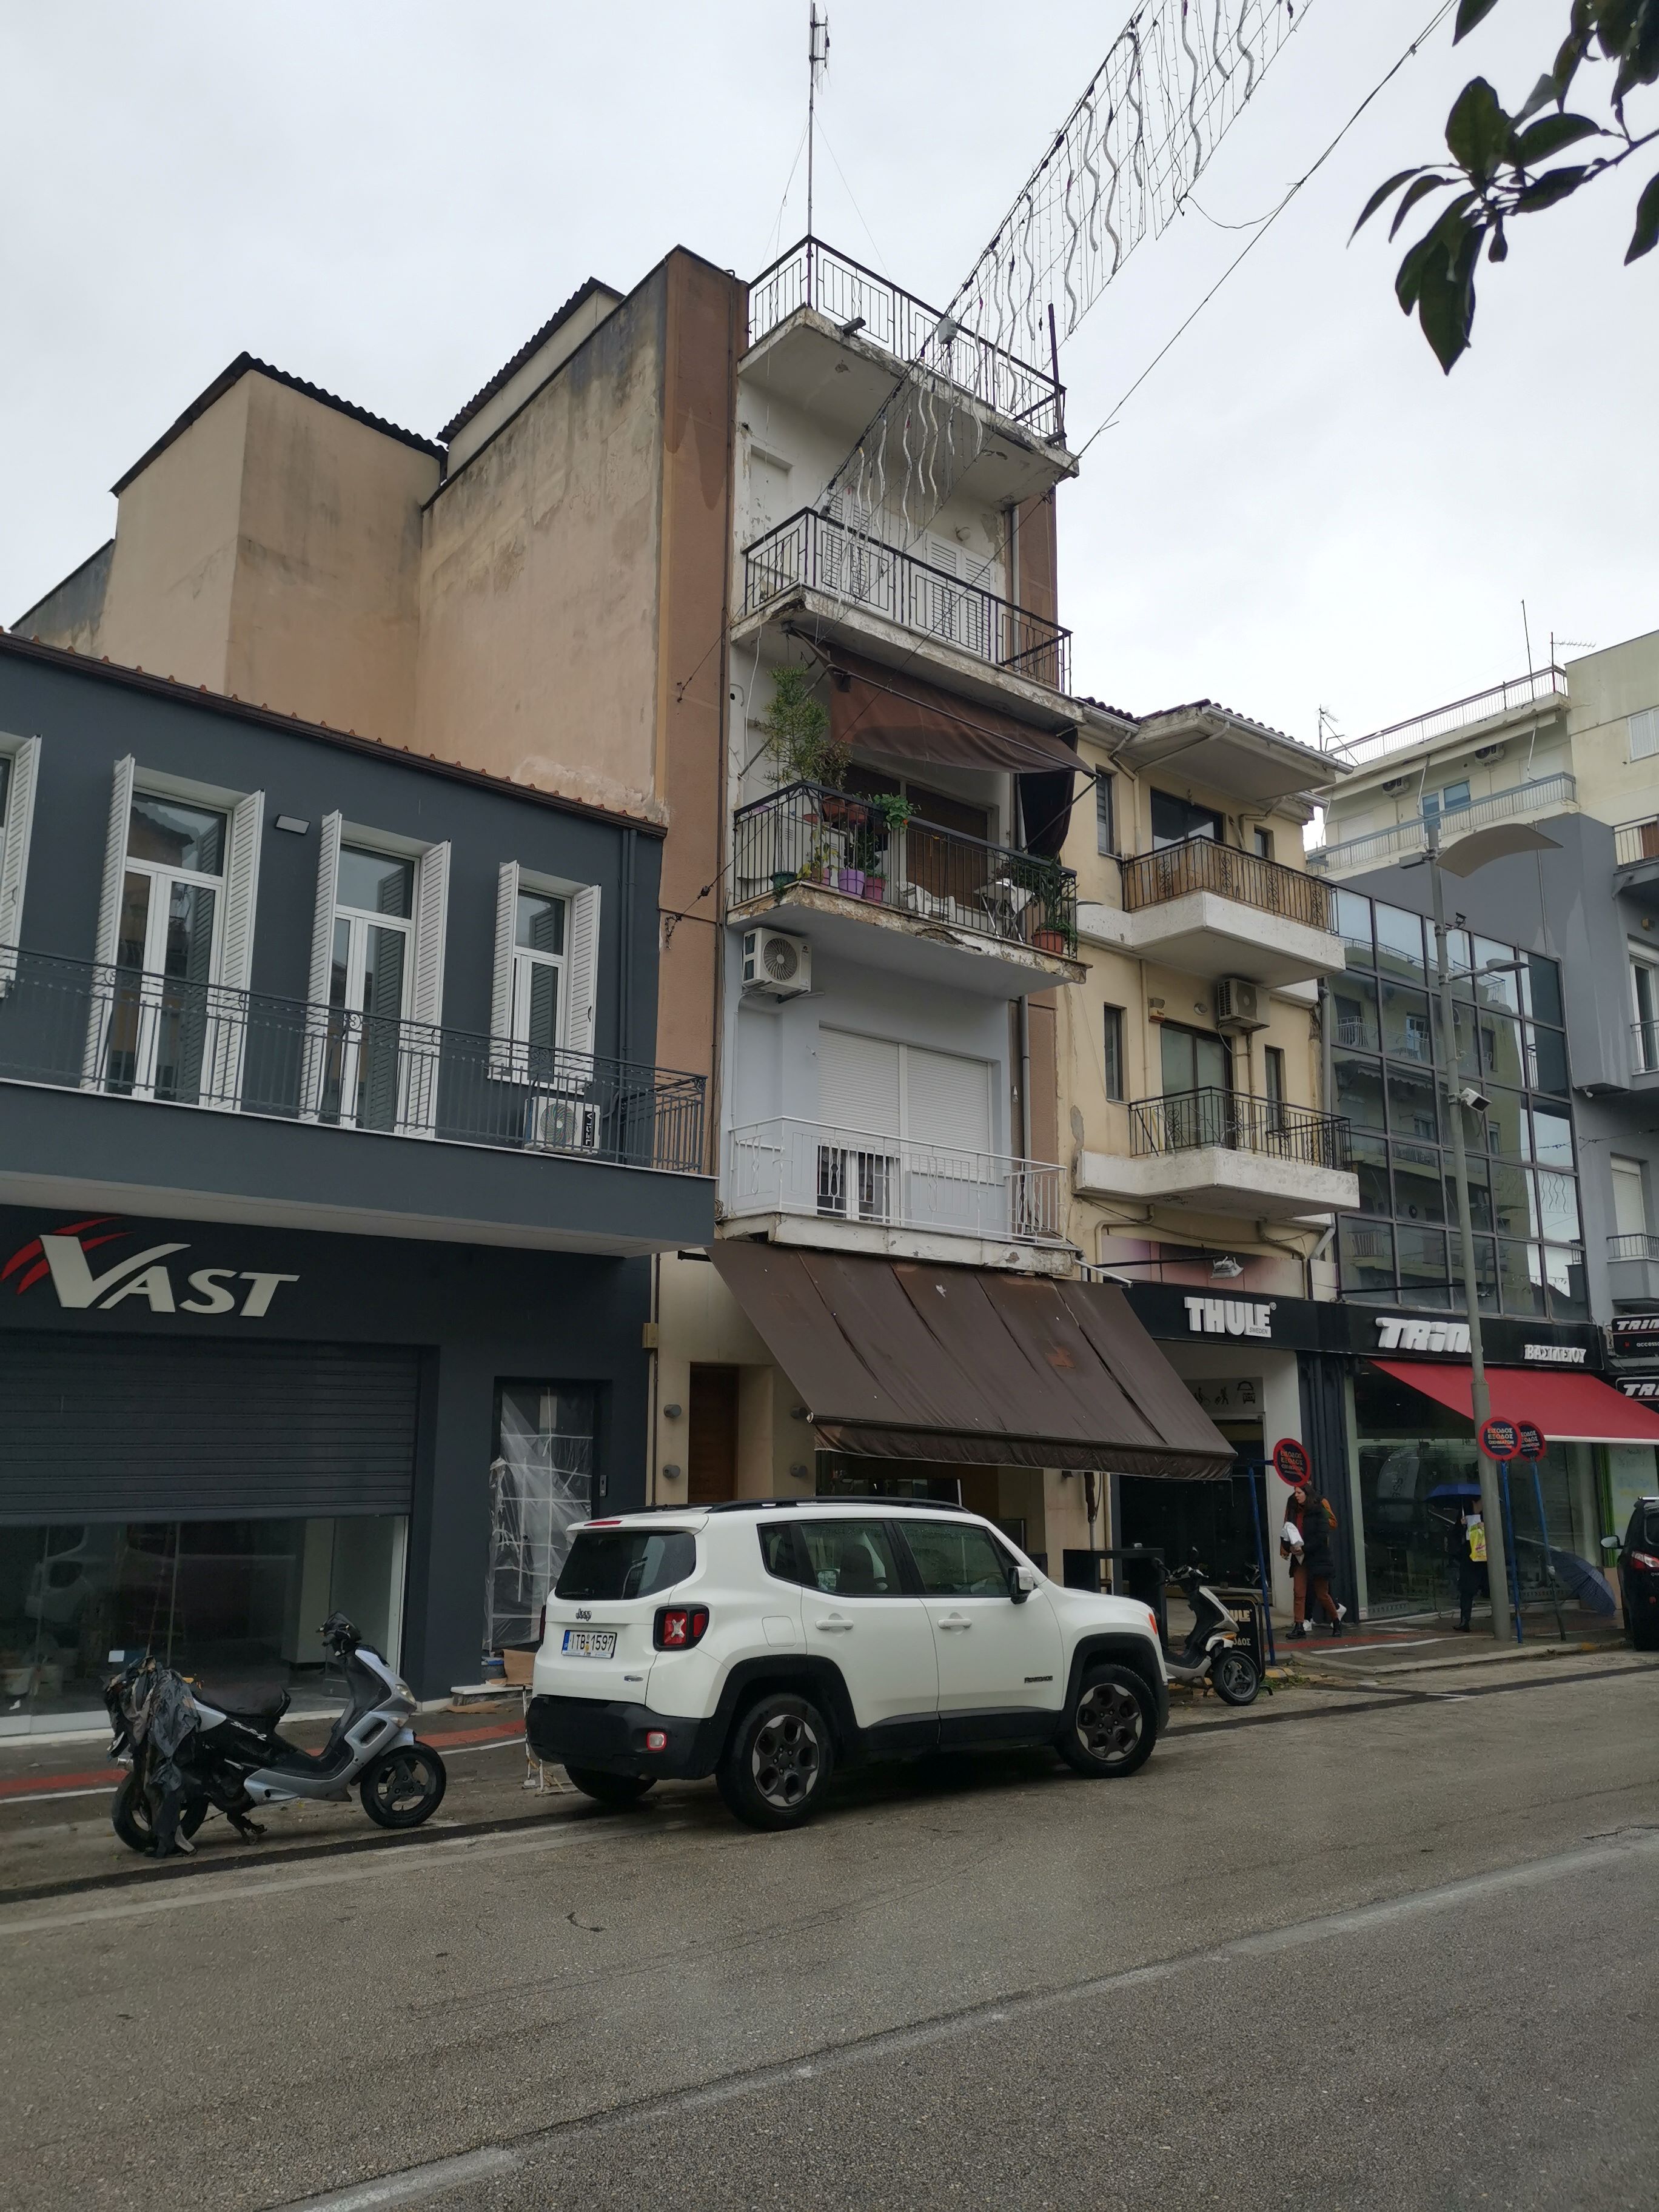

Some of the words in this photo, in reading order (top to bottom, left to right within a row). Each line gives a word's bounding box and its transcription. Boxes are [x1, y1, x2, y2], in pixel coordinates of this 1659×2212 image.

[39, 1235, 301, 1317] VAST
[1184, 1296, 1272, 1338] THULE
[1249, 1326, 1268, 1335] SWEDEN
[1524, 1344, 1587, 1363] ΒΑΣΙΛΕΙΟΥ
[1623, 1383, 1659, 1397] TR
[576, 1608, 592, 1621] Jeep
[1229, 1609, 1251, 1622] ULE
